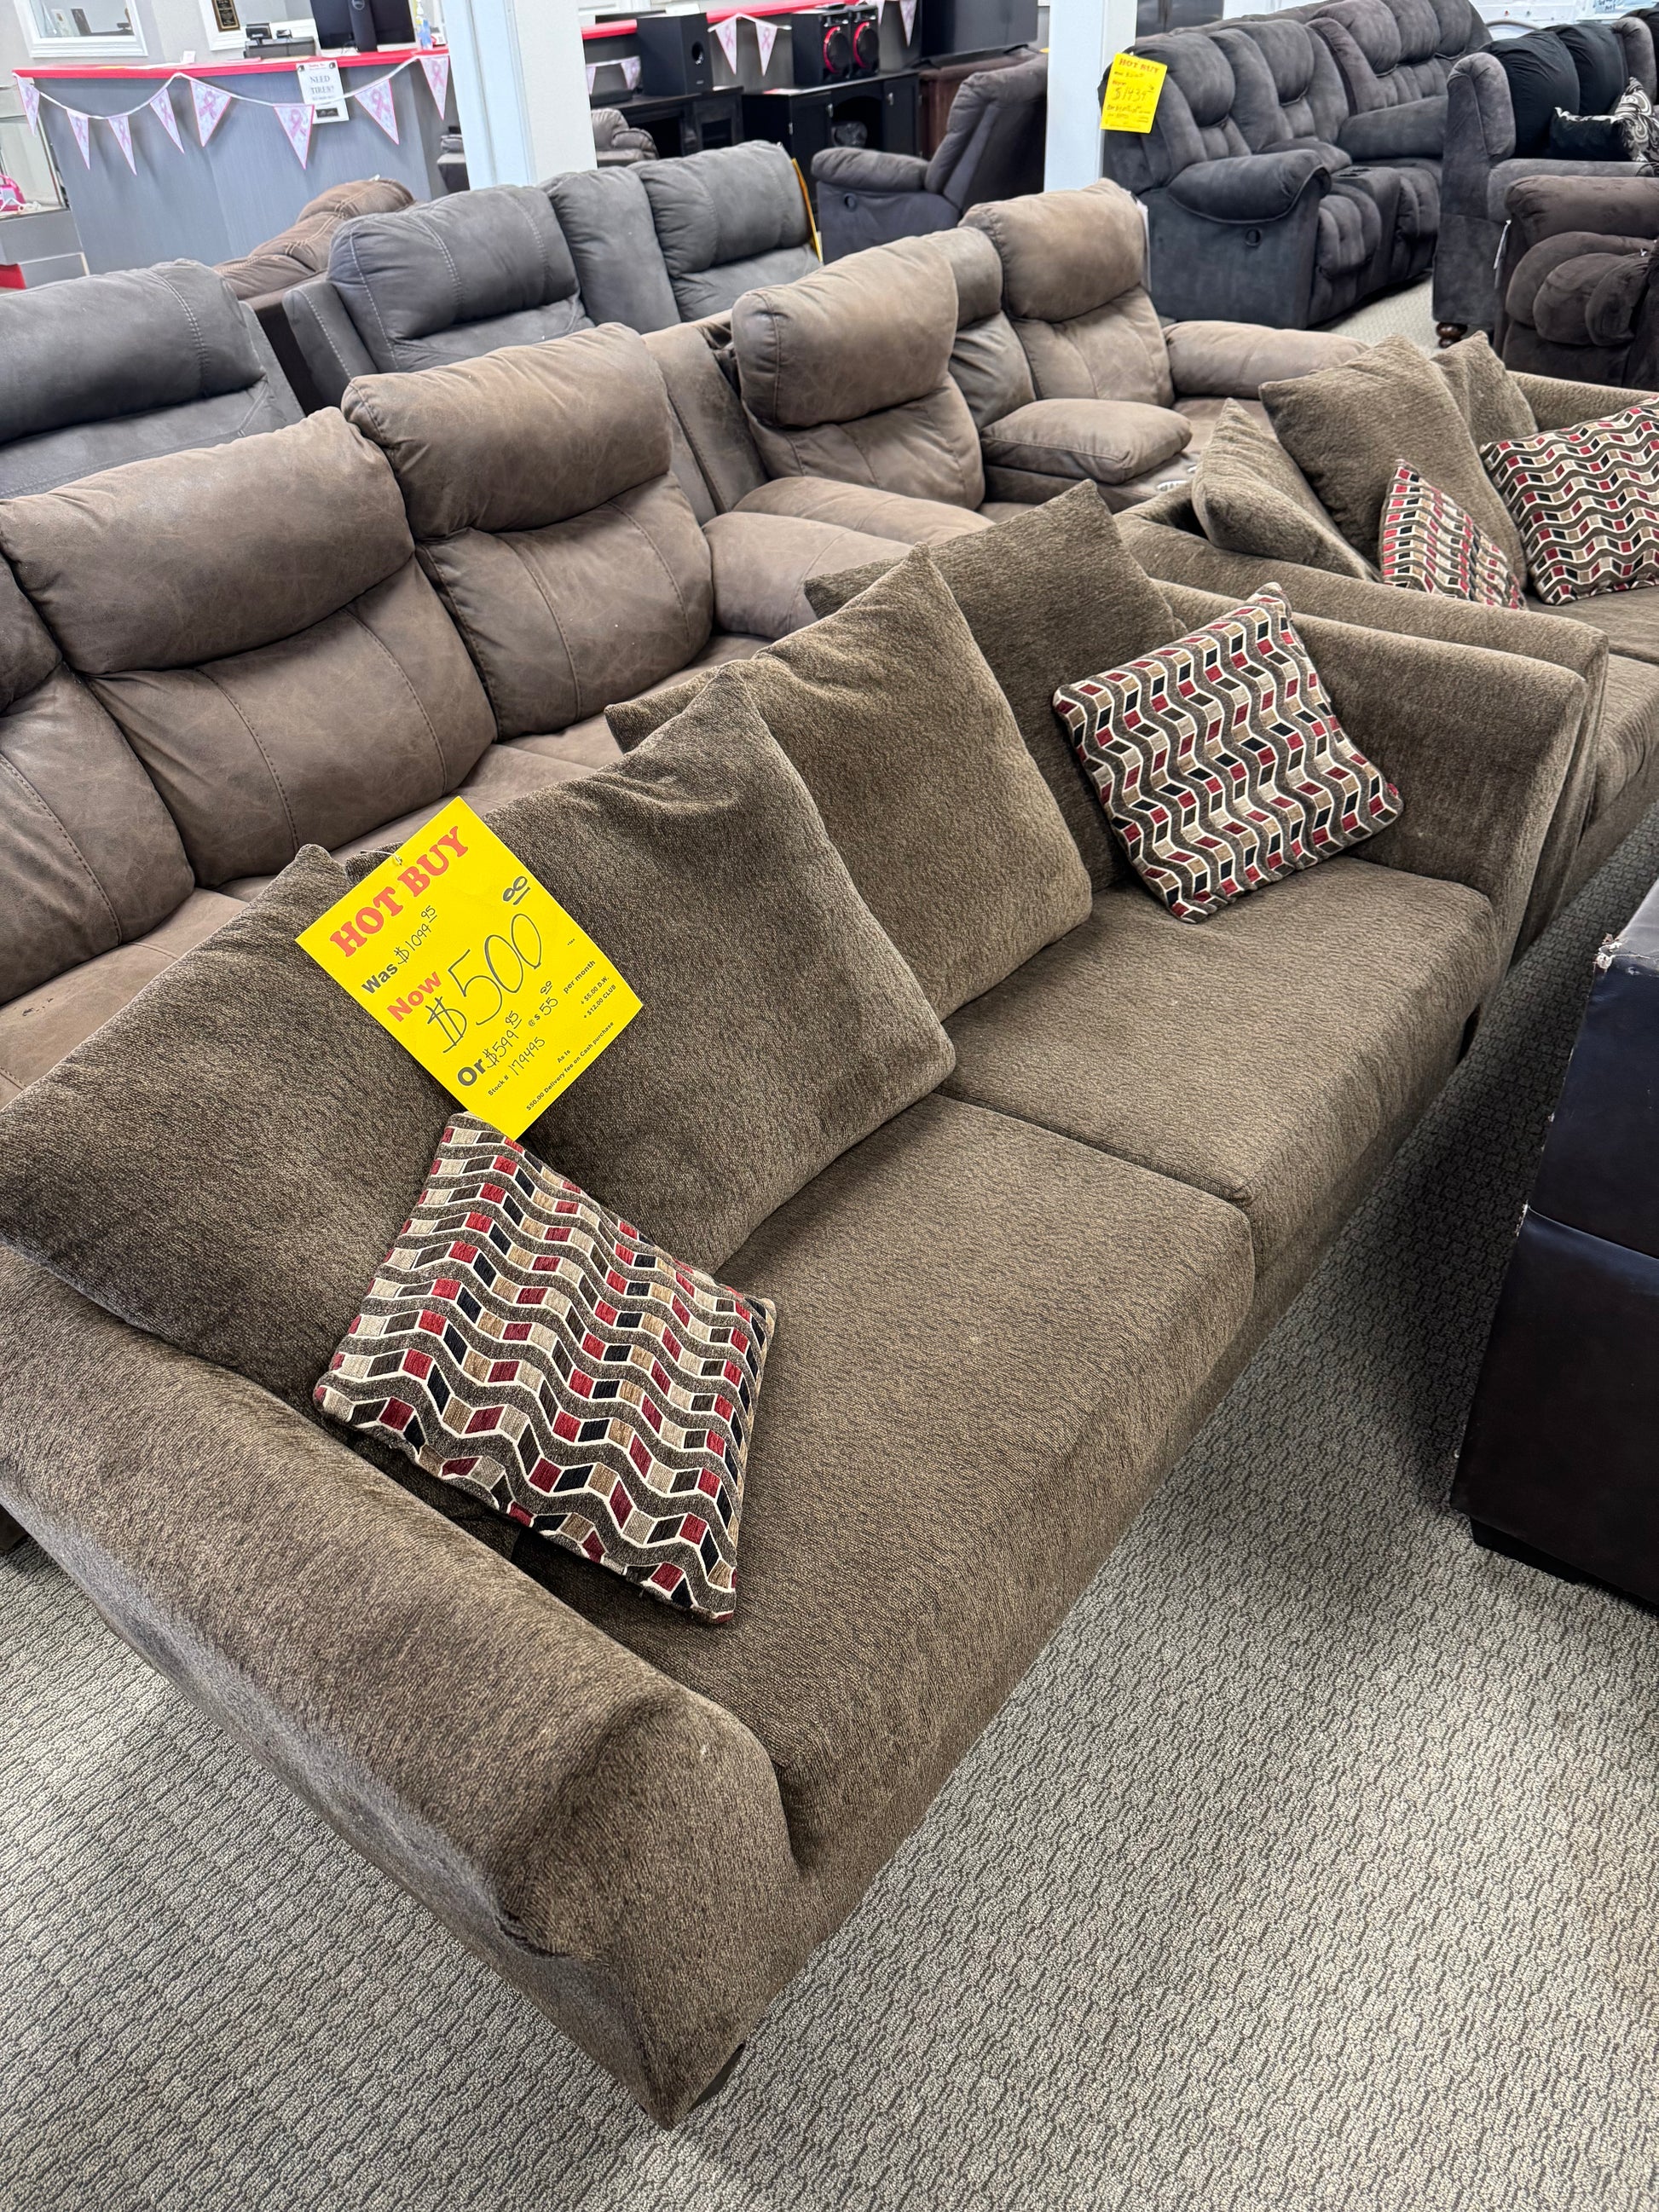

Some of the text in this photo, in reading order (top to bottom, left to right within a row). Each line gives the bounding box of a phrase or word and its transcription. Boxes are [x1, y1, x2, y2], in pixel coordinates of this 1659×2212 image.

[1119, 58, 1138, 68] HOT
[330, 826, 468, 957] HOT BUY
[361, 963, 398, 994] Was
[584, 986, 598, 1002] $5.00
[386, 971, 442, 1022] Now
[587, 997, 604, 1015] $12.00
[602, 984, 616, 999] CLUB
[457, 1058, 486, 1087] Or
[563, 980, 575, 994] per
[575, 960, 596, 981] month
[526, 1092, 545, 1111] $50.00
[543, 1071, 565, 1093] Delivery
[564, 1064, 574, 1073] fee
[580, 1042, 593, 1057] Cash
[592, 1021, 615, 1045] purchase
[488, 1080, 506, 1096] Stock
